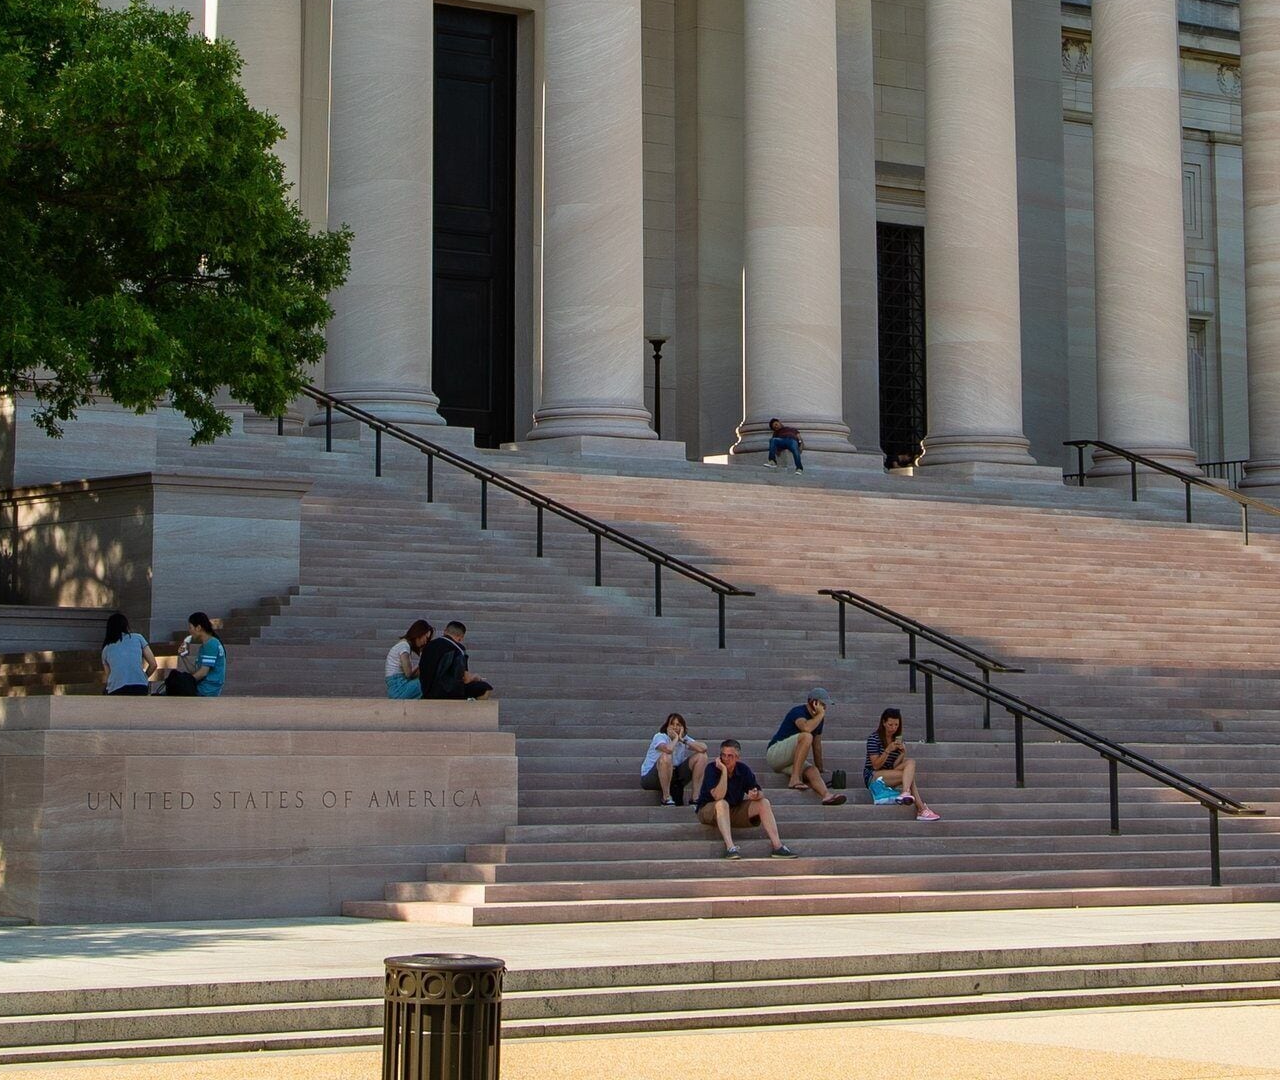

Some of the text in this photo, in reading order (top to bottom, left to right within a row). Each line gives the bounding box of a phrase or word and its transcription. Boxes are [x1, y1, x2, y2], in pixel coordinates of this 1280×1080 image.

[86, 789, 483, 811] UNITED STATES OF AMERICA
